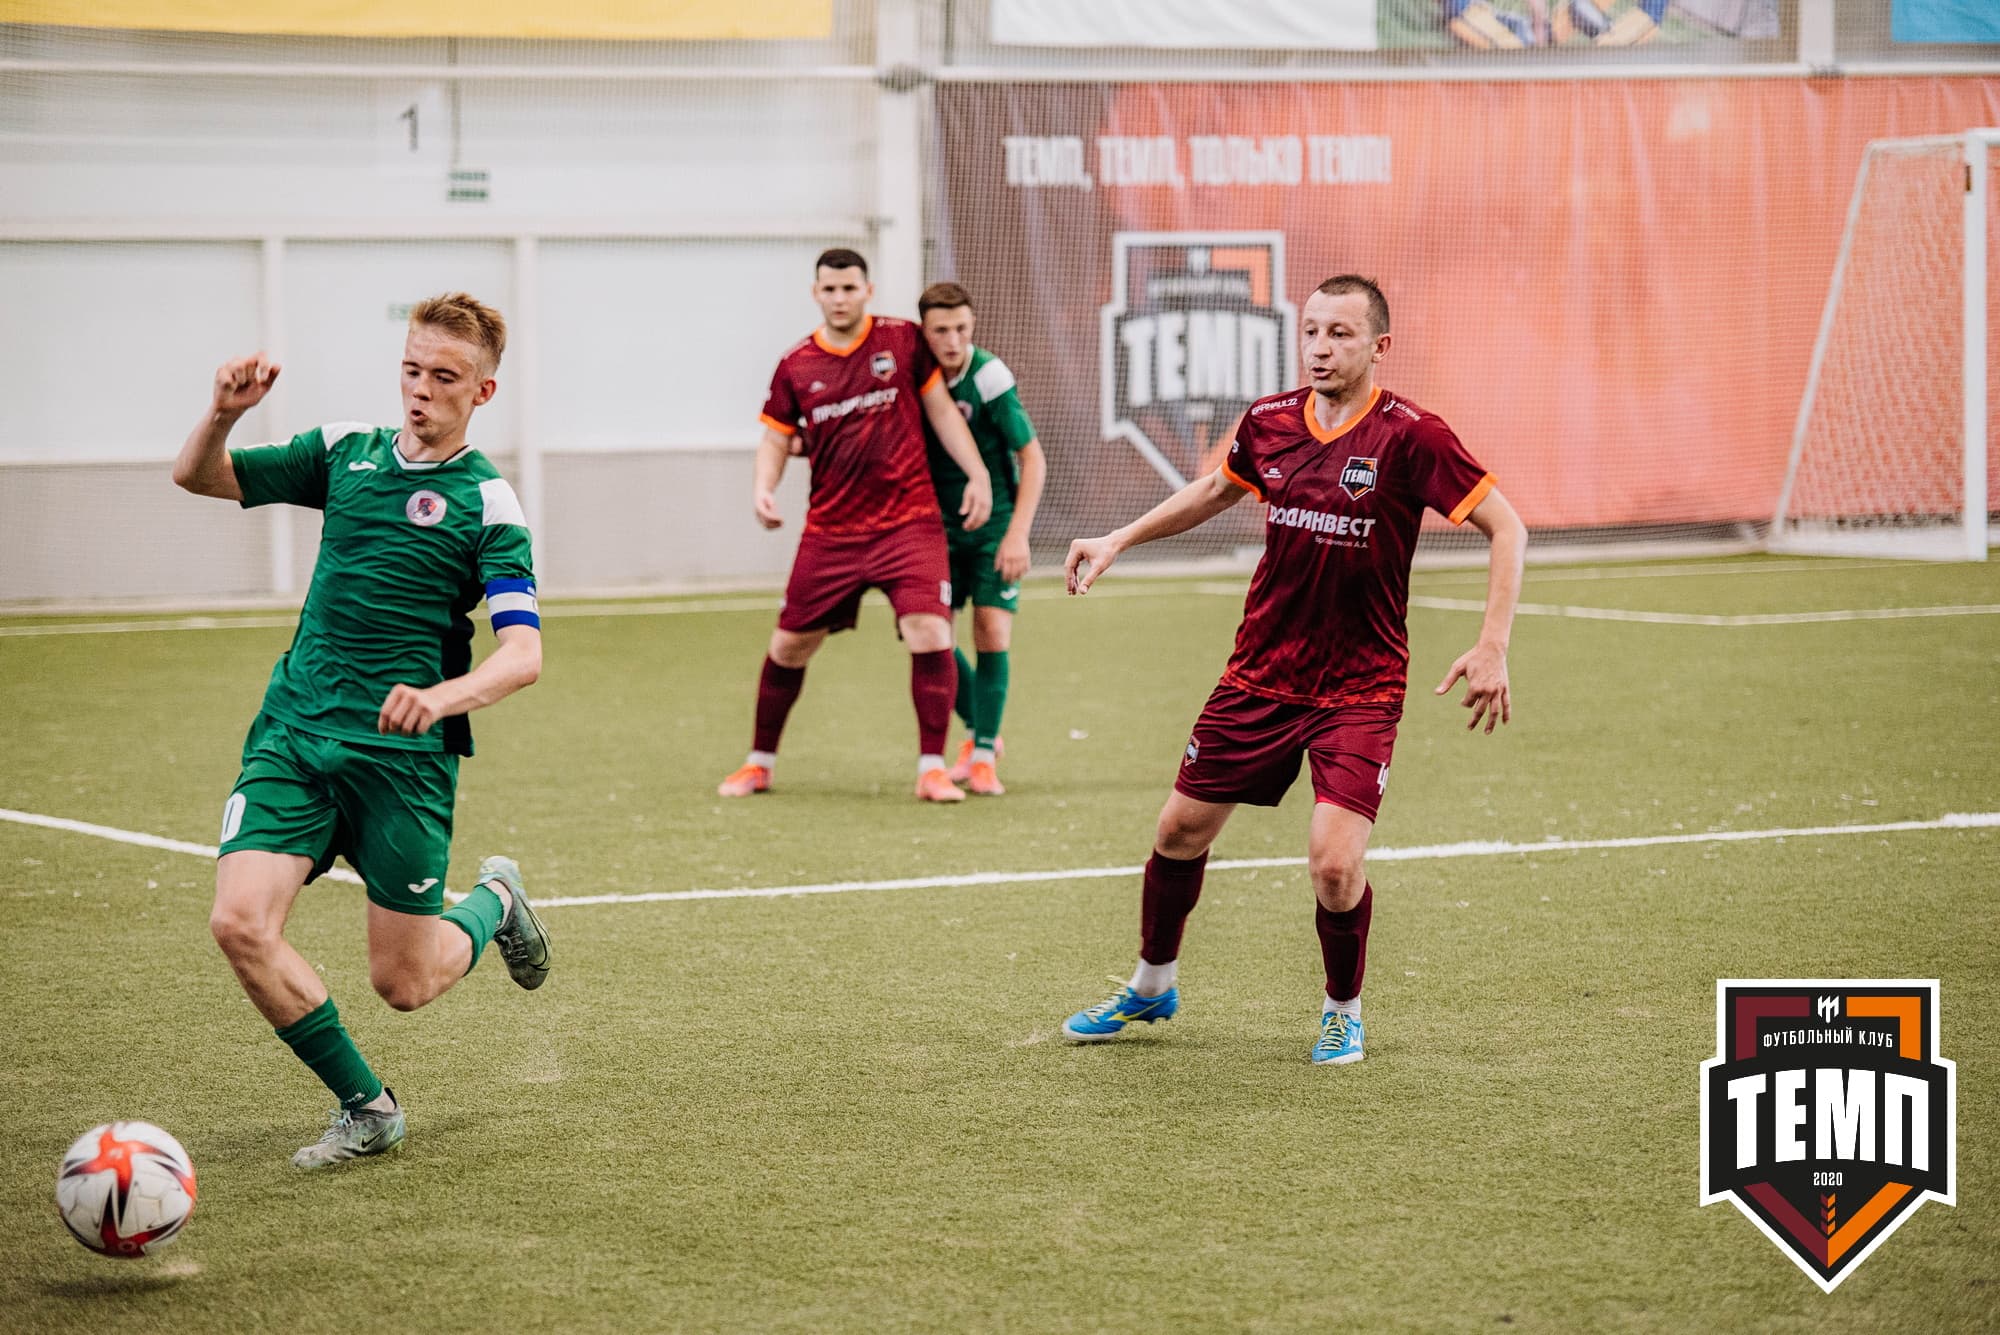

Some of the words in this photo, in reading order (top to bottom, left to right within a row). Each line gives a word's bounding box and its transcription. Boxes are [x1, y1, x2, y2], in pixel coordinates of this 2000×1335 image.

[397, 103, 419, 151] 1
[1004, 135, 1093, 191] ТЕМП,
[1121, 311, 1279, 407] ТЕМП
[1344, 469, 1374, 486] ТЕМП
